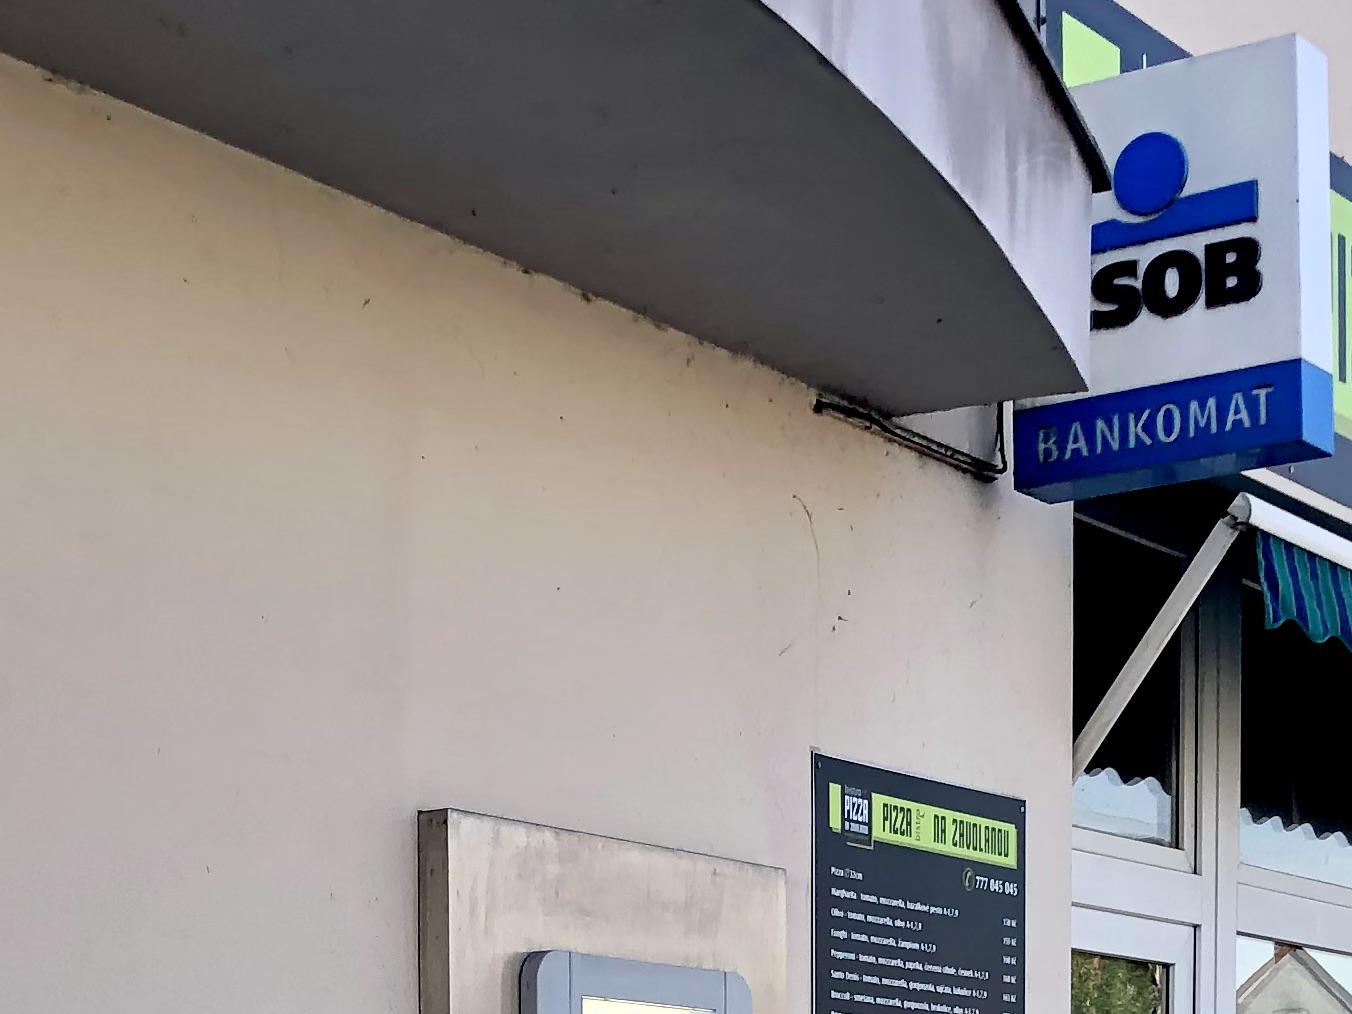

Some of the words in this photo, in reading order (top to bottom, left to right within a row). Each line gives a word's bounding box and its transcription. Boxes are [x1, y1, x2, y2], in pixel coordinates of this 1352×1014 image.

[1090, 236, 1263, 330] SOB
[1038, 384, 1274, 463] BANKOMAT
[844, 795, 869, 824] PIZZA
[882, 803, 912, 838] PIZZA
[933, 814, 946, 845] NA
[951, 818, 1009, 858] ZAVOLANOU
